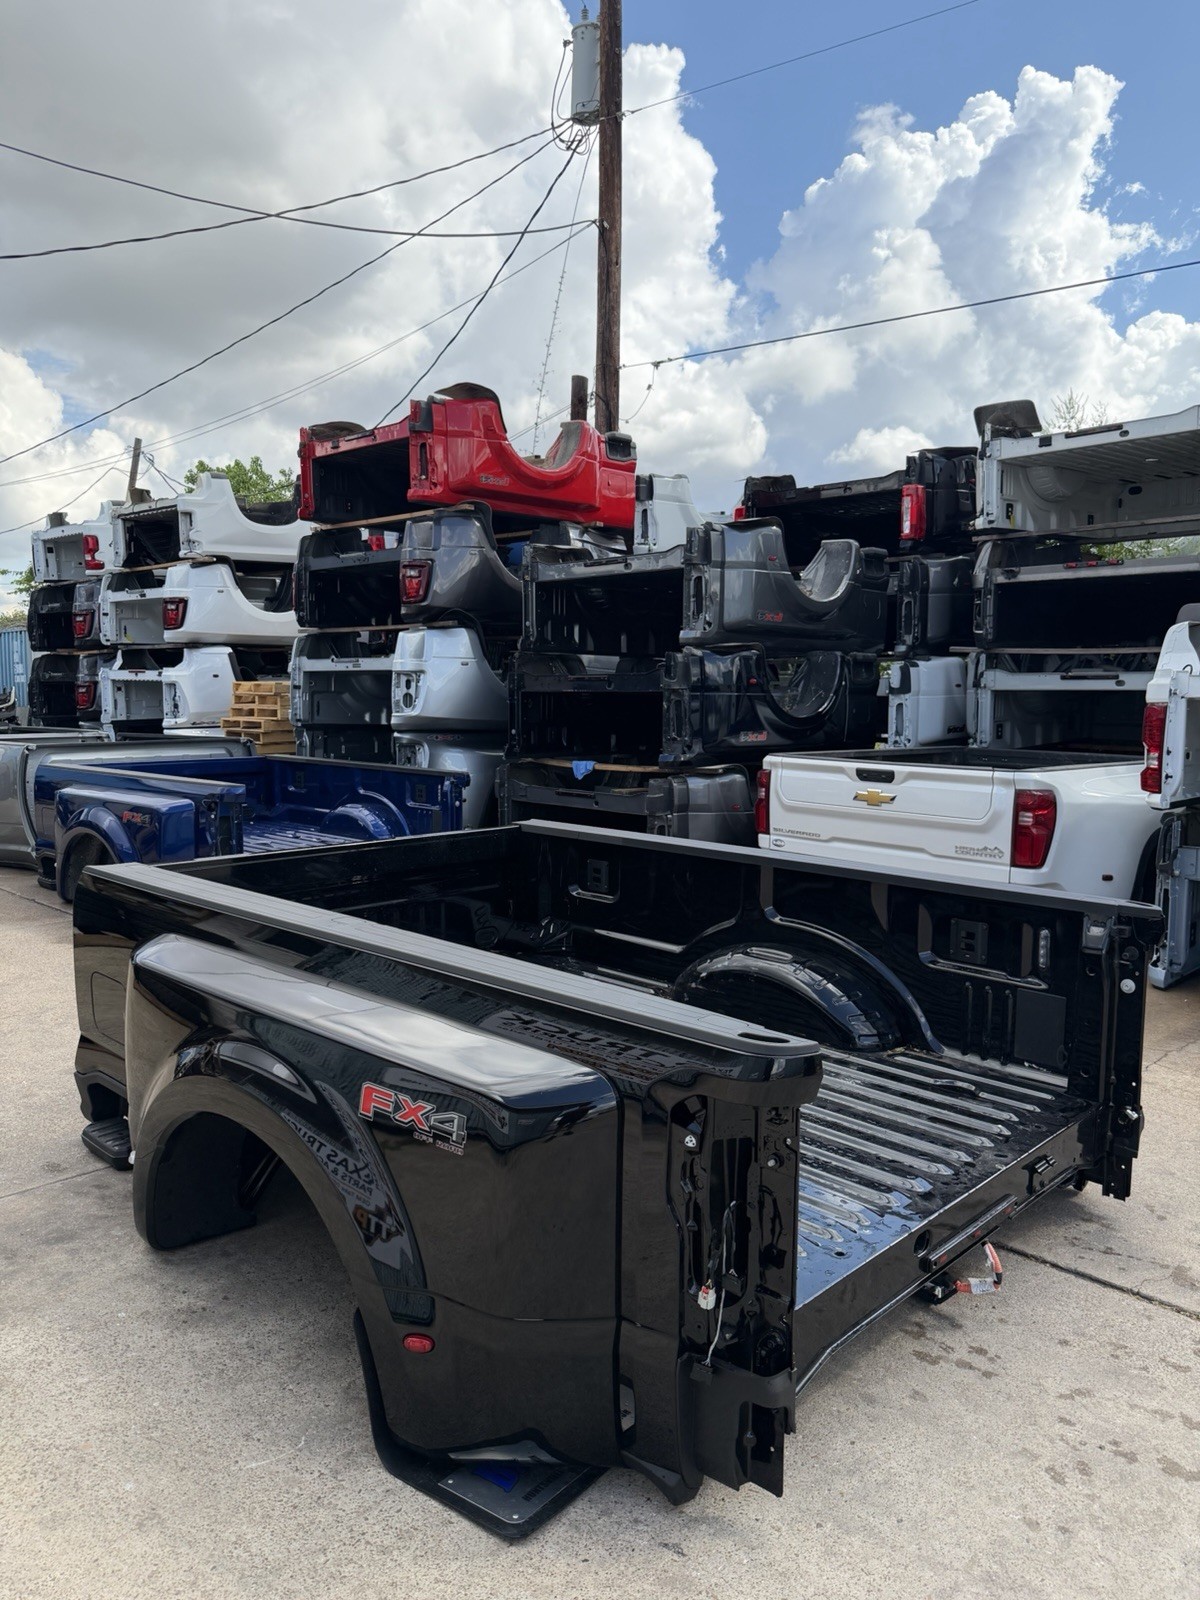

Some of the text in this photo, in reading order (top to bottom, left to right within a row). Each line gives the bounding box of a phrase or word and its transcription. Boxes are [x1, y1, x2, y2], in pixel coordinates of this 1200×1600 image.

[122, 810, 151, 825] FX4
[772, 827, 821, 838] SILVERADO
[954, 850, 1005, 859] COUNTRY
[358, 1081, 467, 1148] FX4
